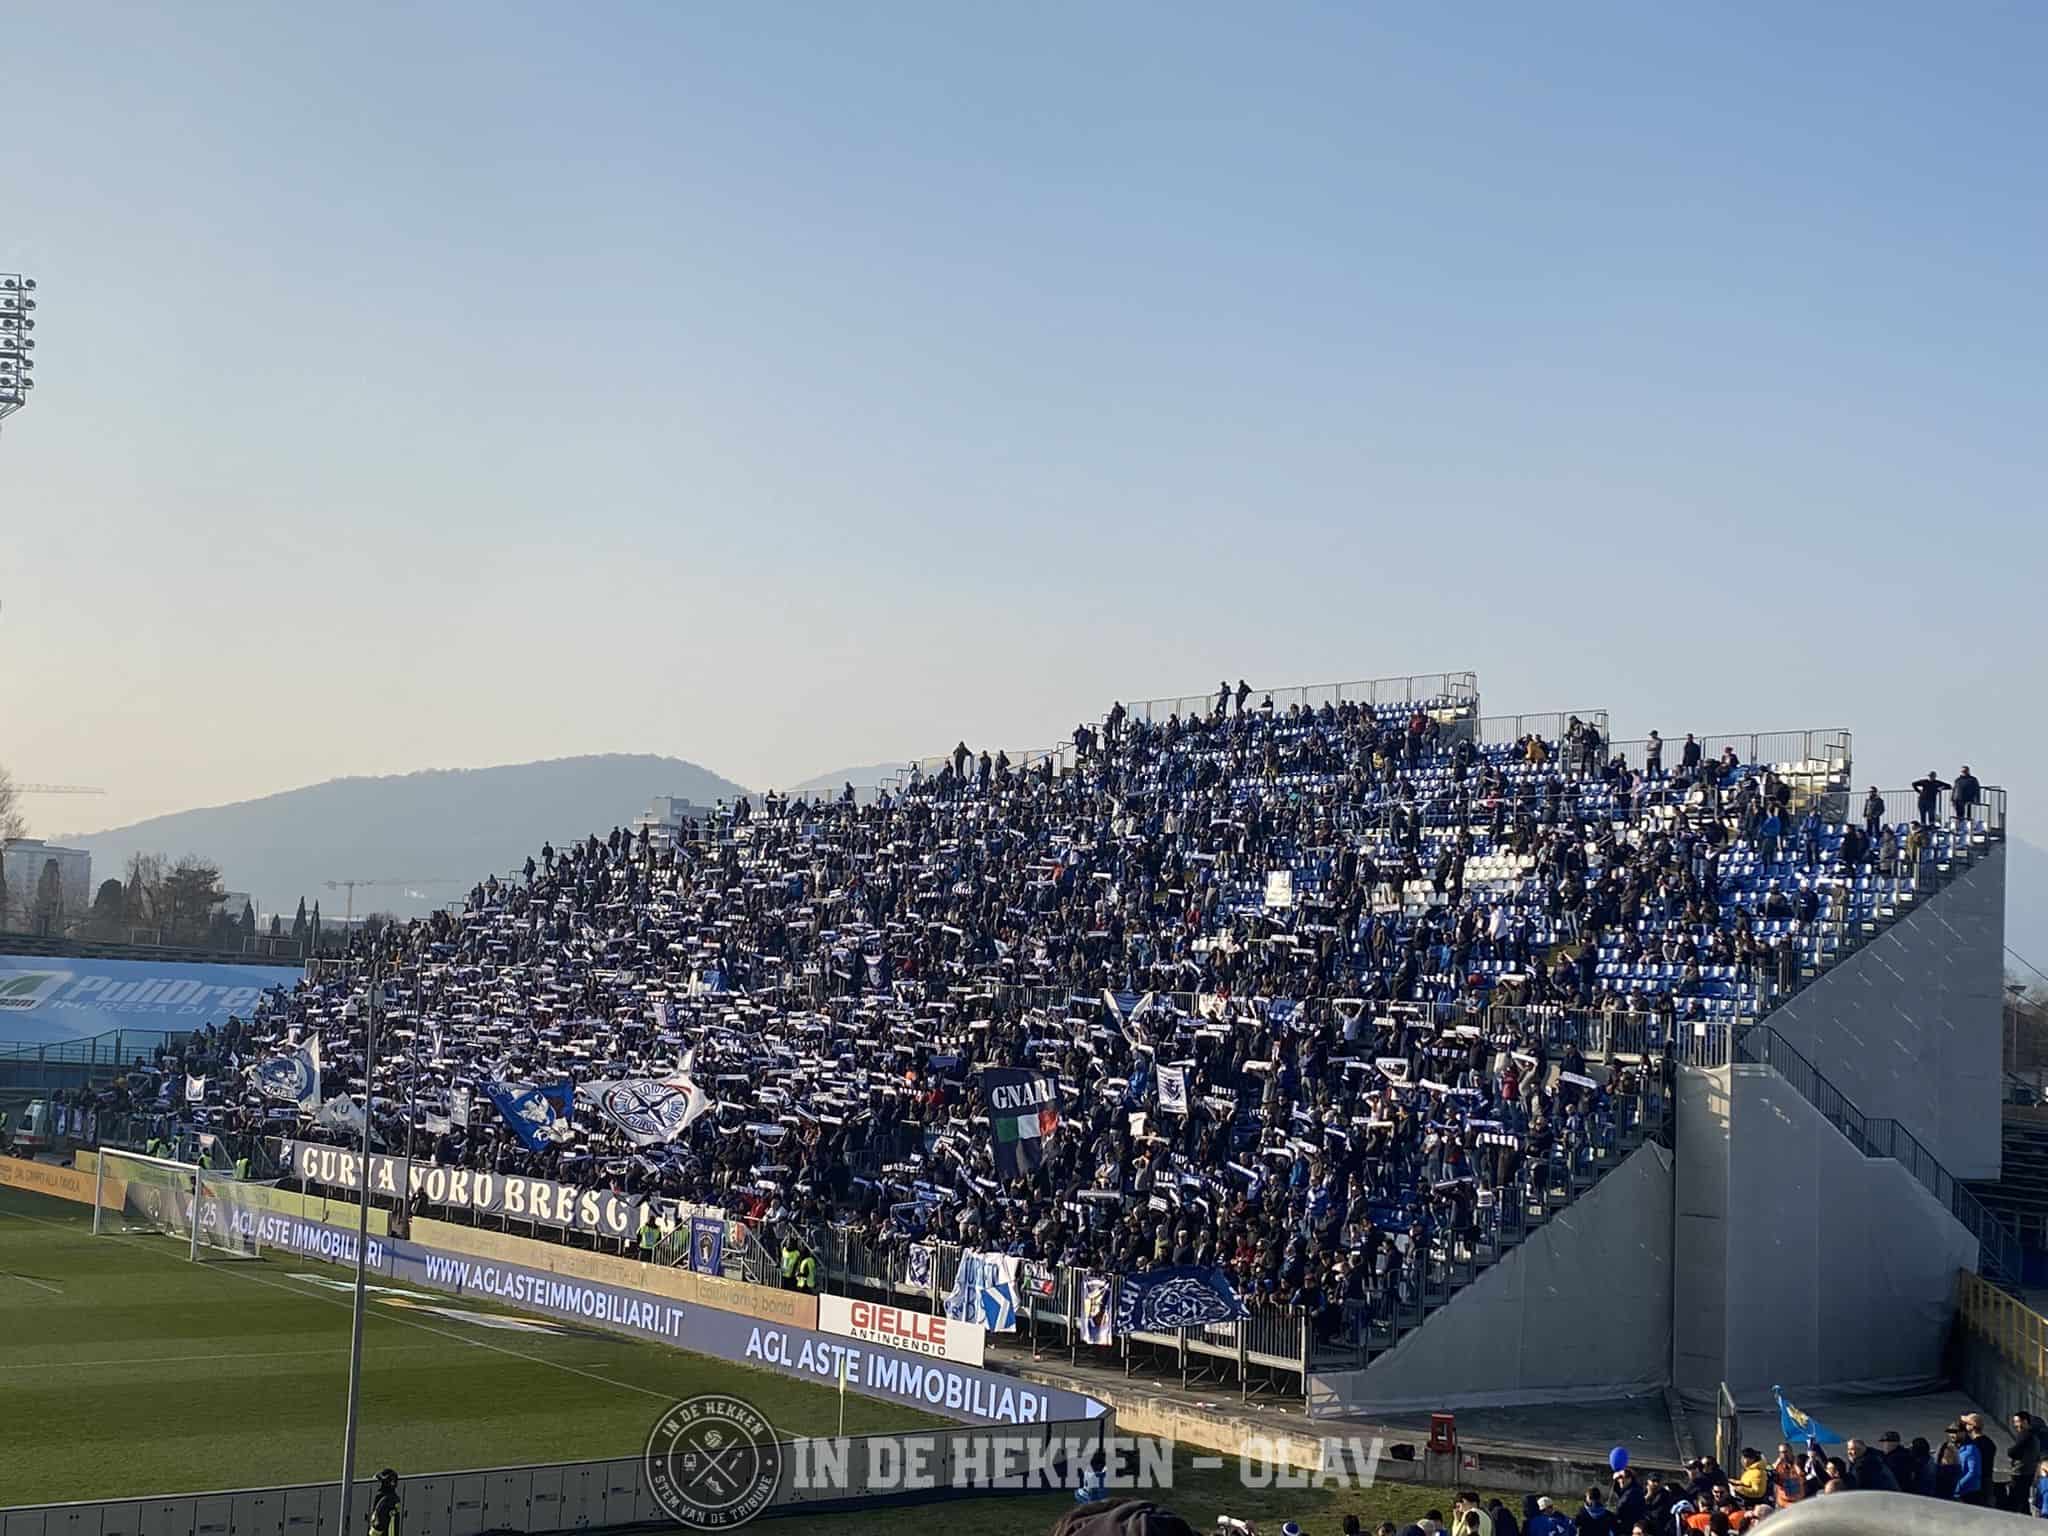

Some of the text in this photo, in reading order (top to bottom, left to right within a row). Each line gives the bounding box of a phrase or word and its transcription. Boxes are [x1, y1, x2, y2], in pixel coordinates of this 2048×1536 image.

[992, 1078, 1057, 1110] GNARI
[231, 1209, 384, 1269] AGL ASTE IMMOBILIRI
[425, 1254, 684, 1338] WWW.AGLASTEIMMOBILIARI.IT
[850, 1302, 947, 1345] GIELLE
[850, 1327, 947, 1357] ANTINCENDIO
[746, 1327, 1048, 1424] AGL ASTE IMMOBILIARI
